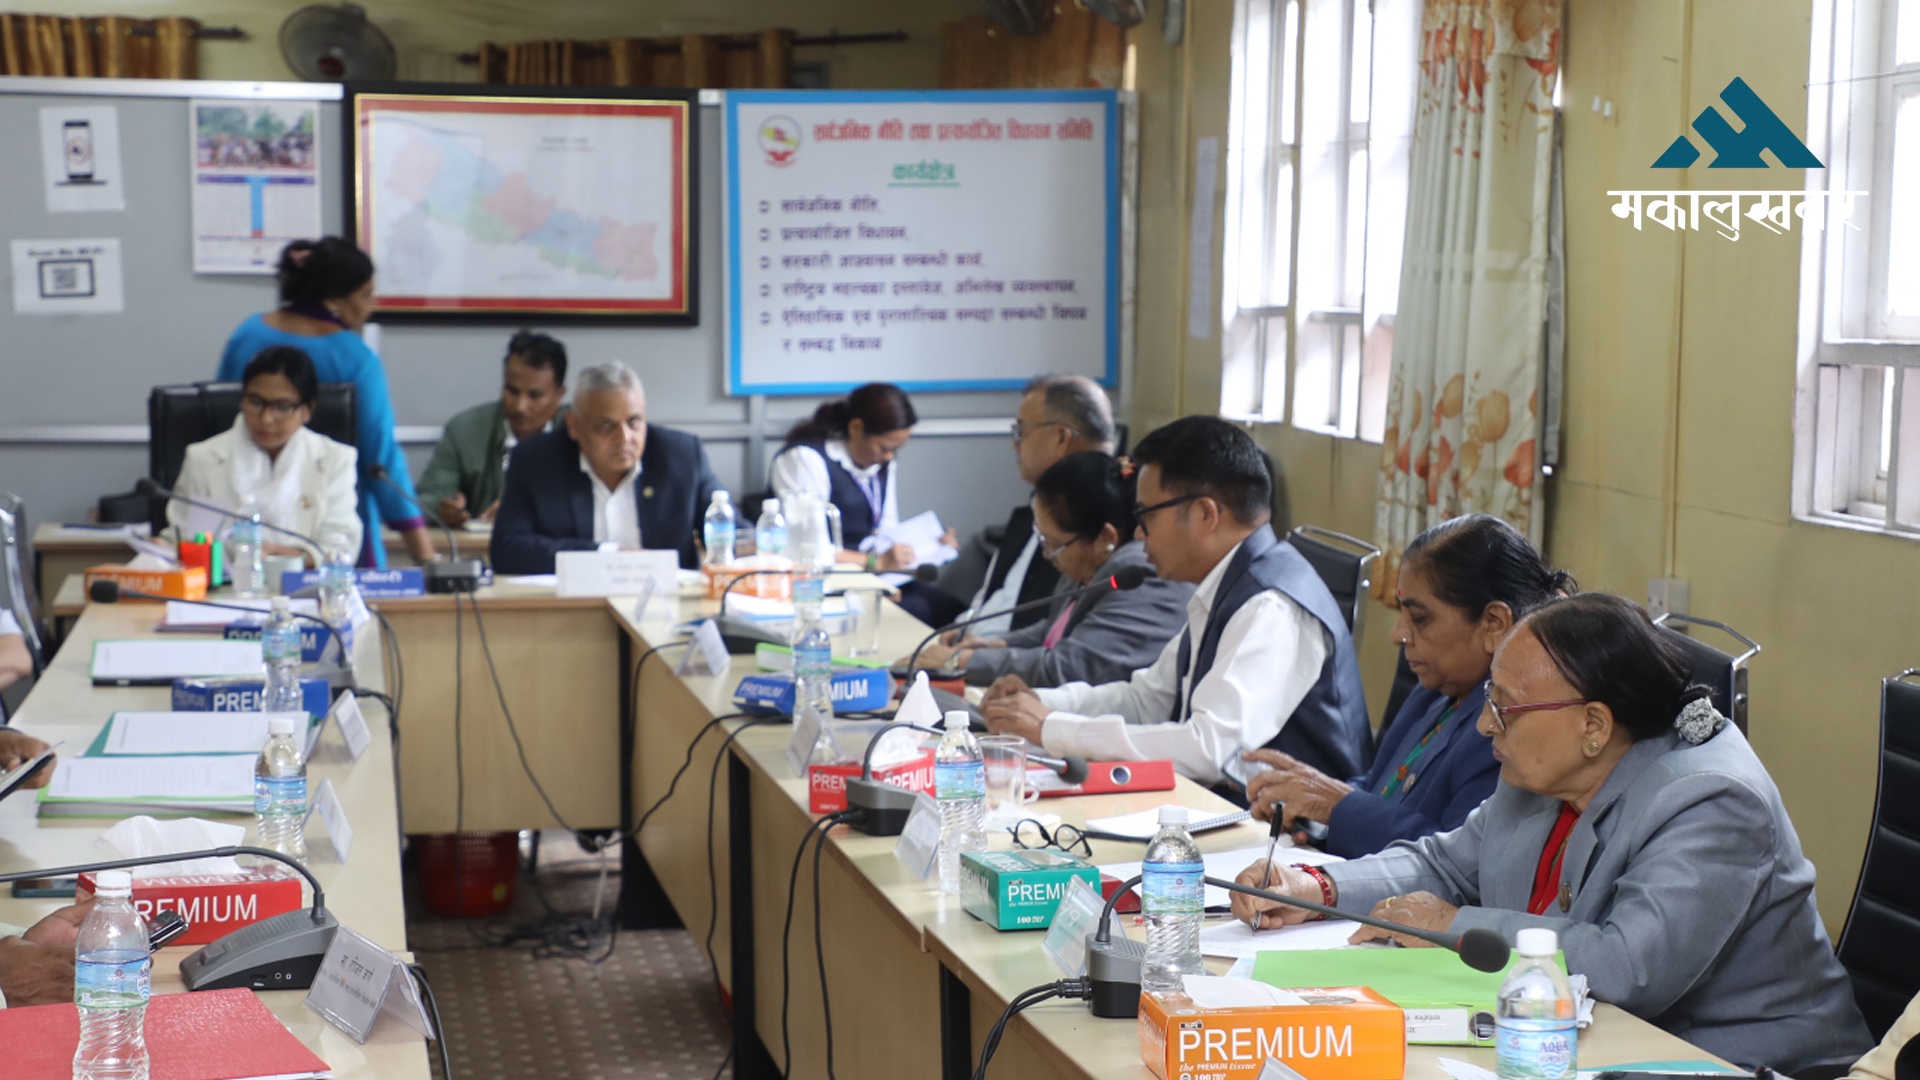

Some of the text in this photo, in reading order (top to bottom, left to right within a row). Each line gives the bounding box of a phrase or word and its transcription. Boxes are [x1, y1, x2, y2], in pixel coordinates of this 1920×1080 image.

[1008, 881, 1094, 902] PREMI
[134, 893, 257, 925] REMIUM
[1179, 1025, 1352, 1062] PREMIUM
[1179, 1063, 1194, 1072] the
[1196, 1062, 1228, 1071] PREMIUM
